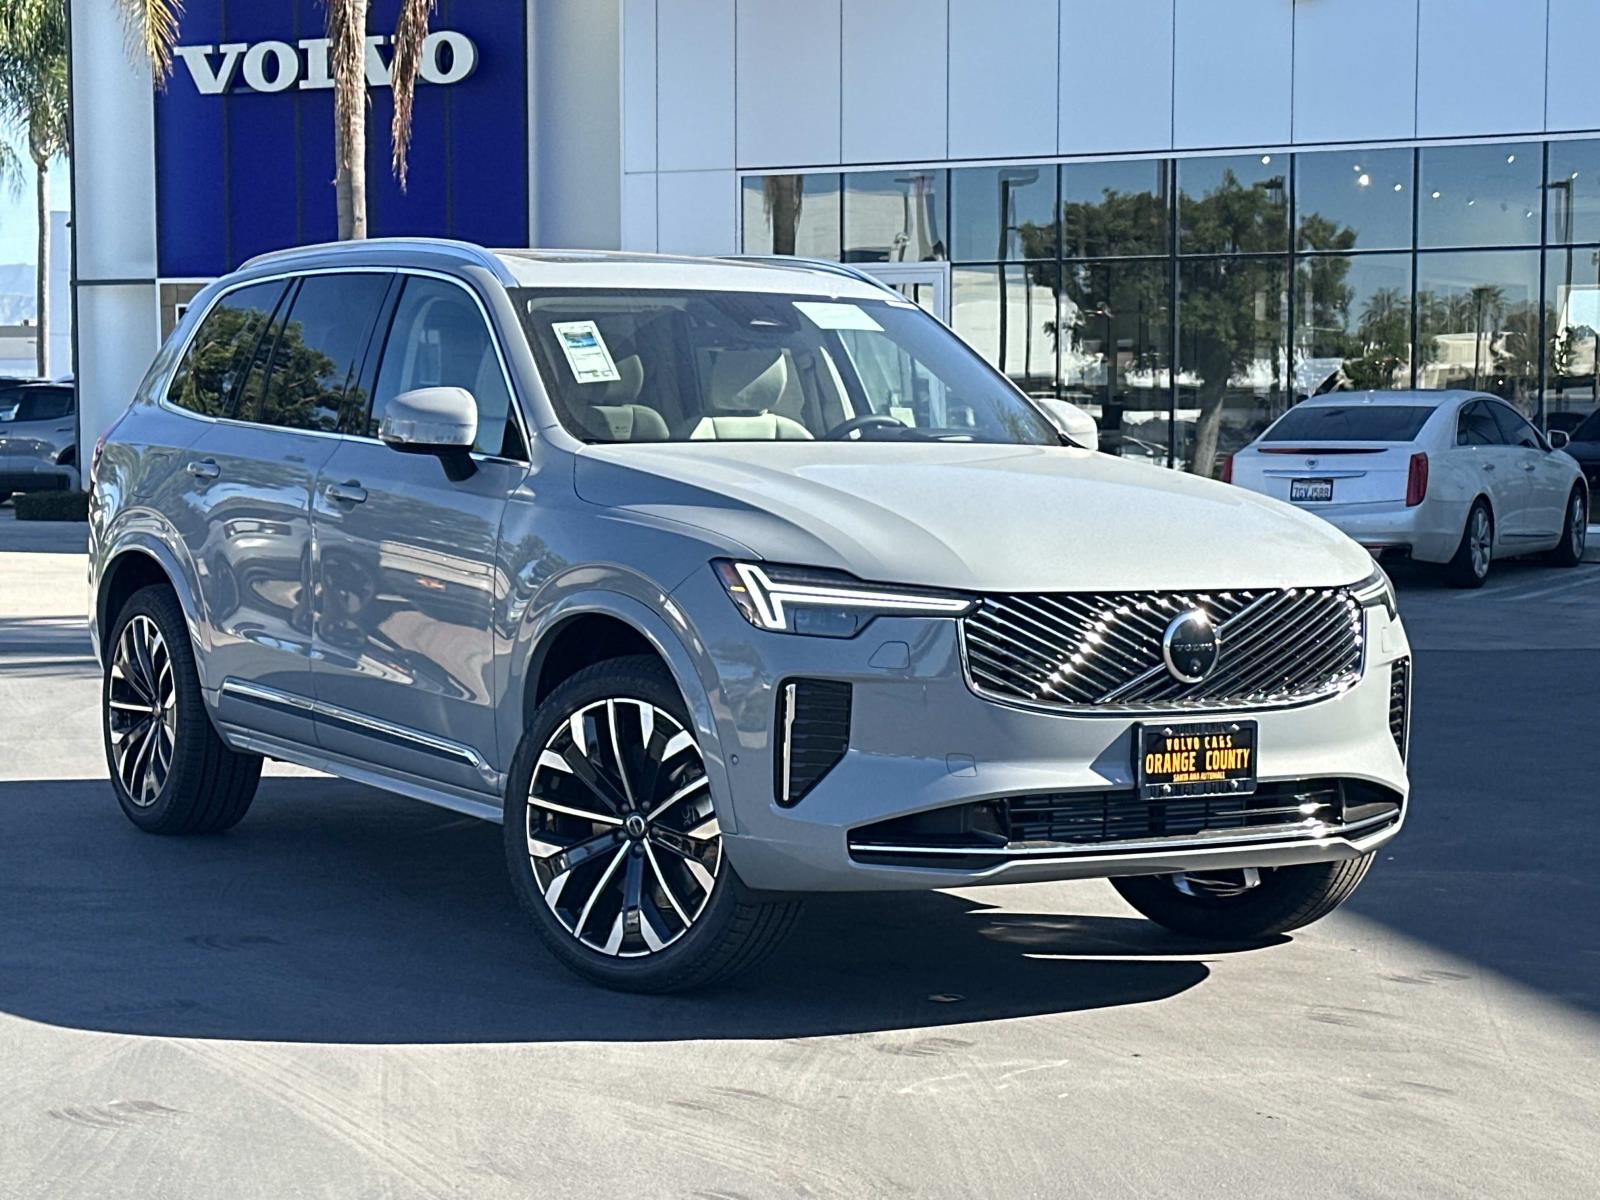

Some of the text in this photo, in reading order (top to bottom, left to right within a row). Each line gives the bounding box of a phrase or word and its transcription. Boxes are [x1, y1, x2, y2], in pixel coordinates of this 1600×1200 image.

[1166, 735, 1232, 752] VOLVO CARS
[1145, 748, 1251, 774] ORANGE COUNTY
